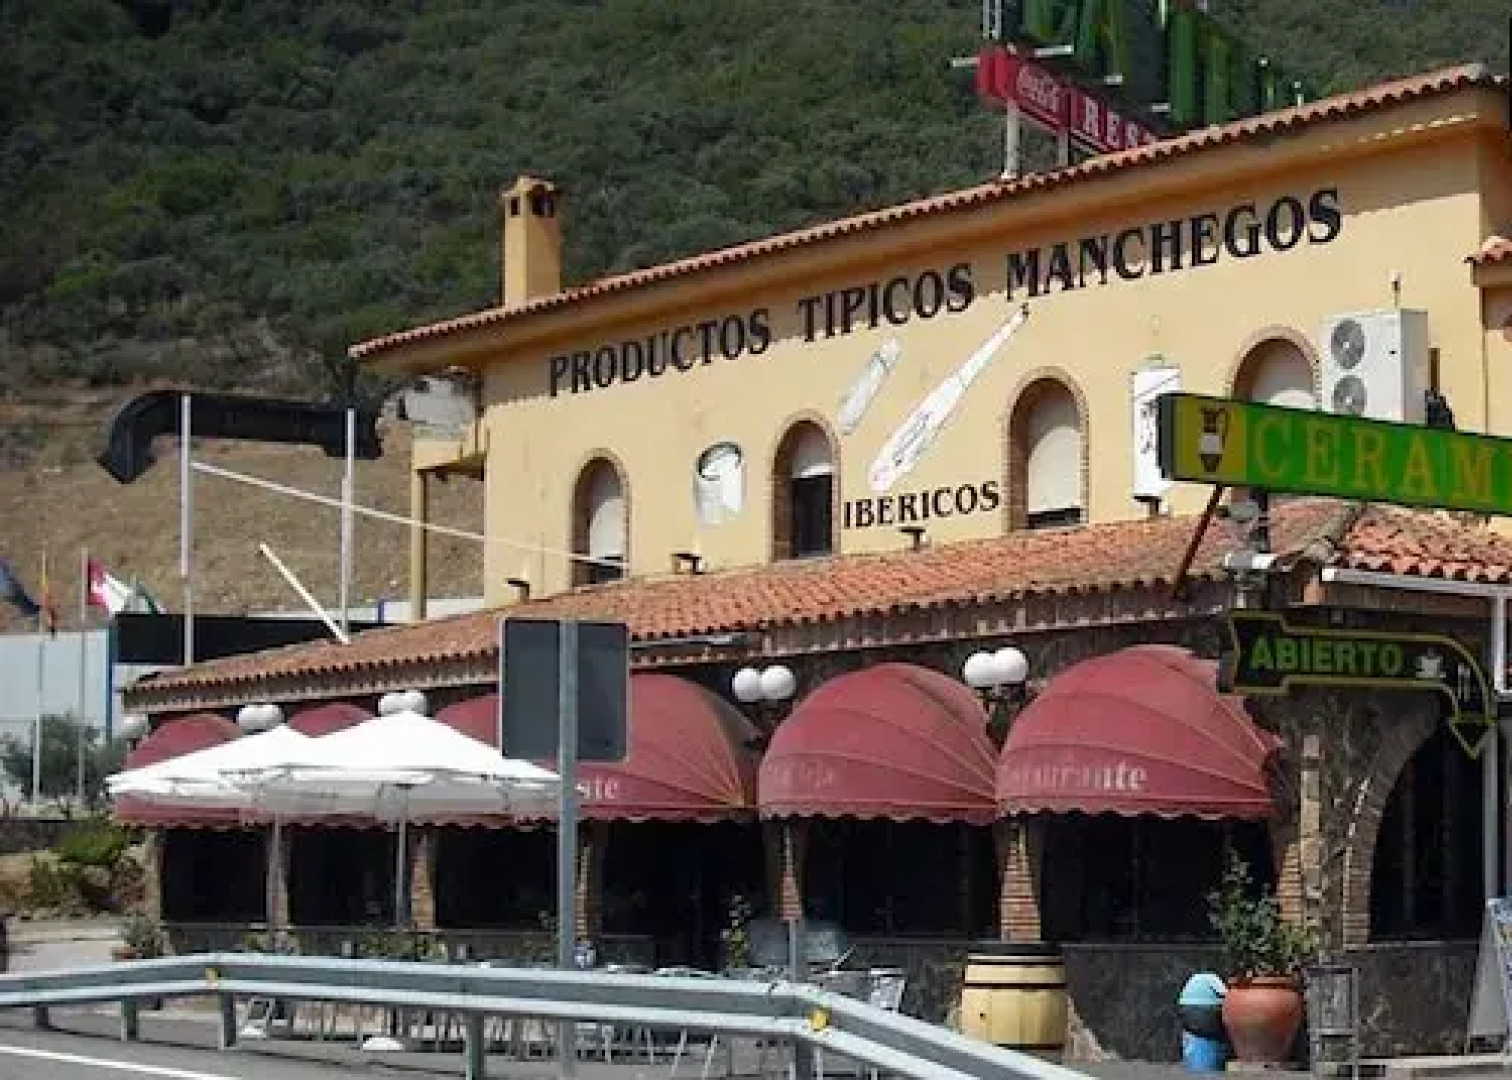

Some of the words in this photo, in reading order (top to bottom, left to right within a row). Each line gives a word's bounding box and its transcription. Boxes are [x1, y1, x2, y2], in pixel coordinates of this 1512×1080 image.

[549, 308, 772, 397] PRODUCTOS
[798, 262, 976, 343] TIPICOS
[1006, 187, 1342, 302] MANCHEGOS
[843, 480, 1000, 530] IBERICOS
[1250, 633, 1403, 677] ABIERTO
